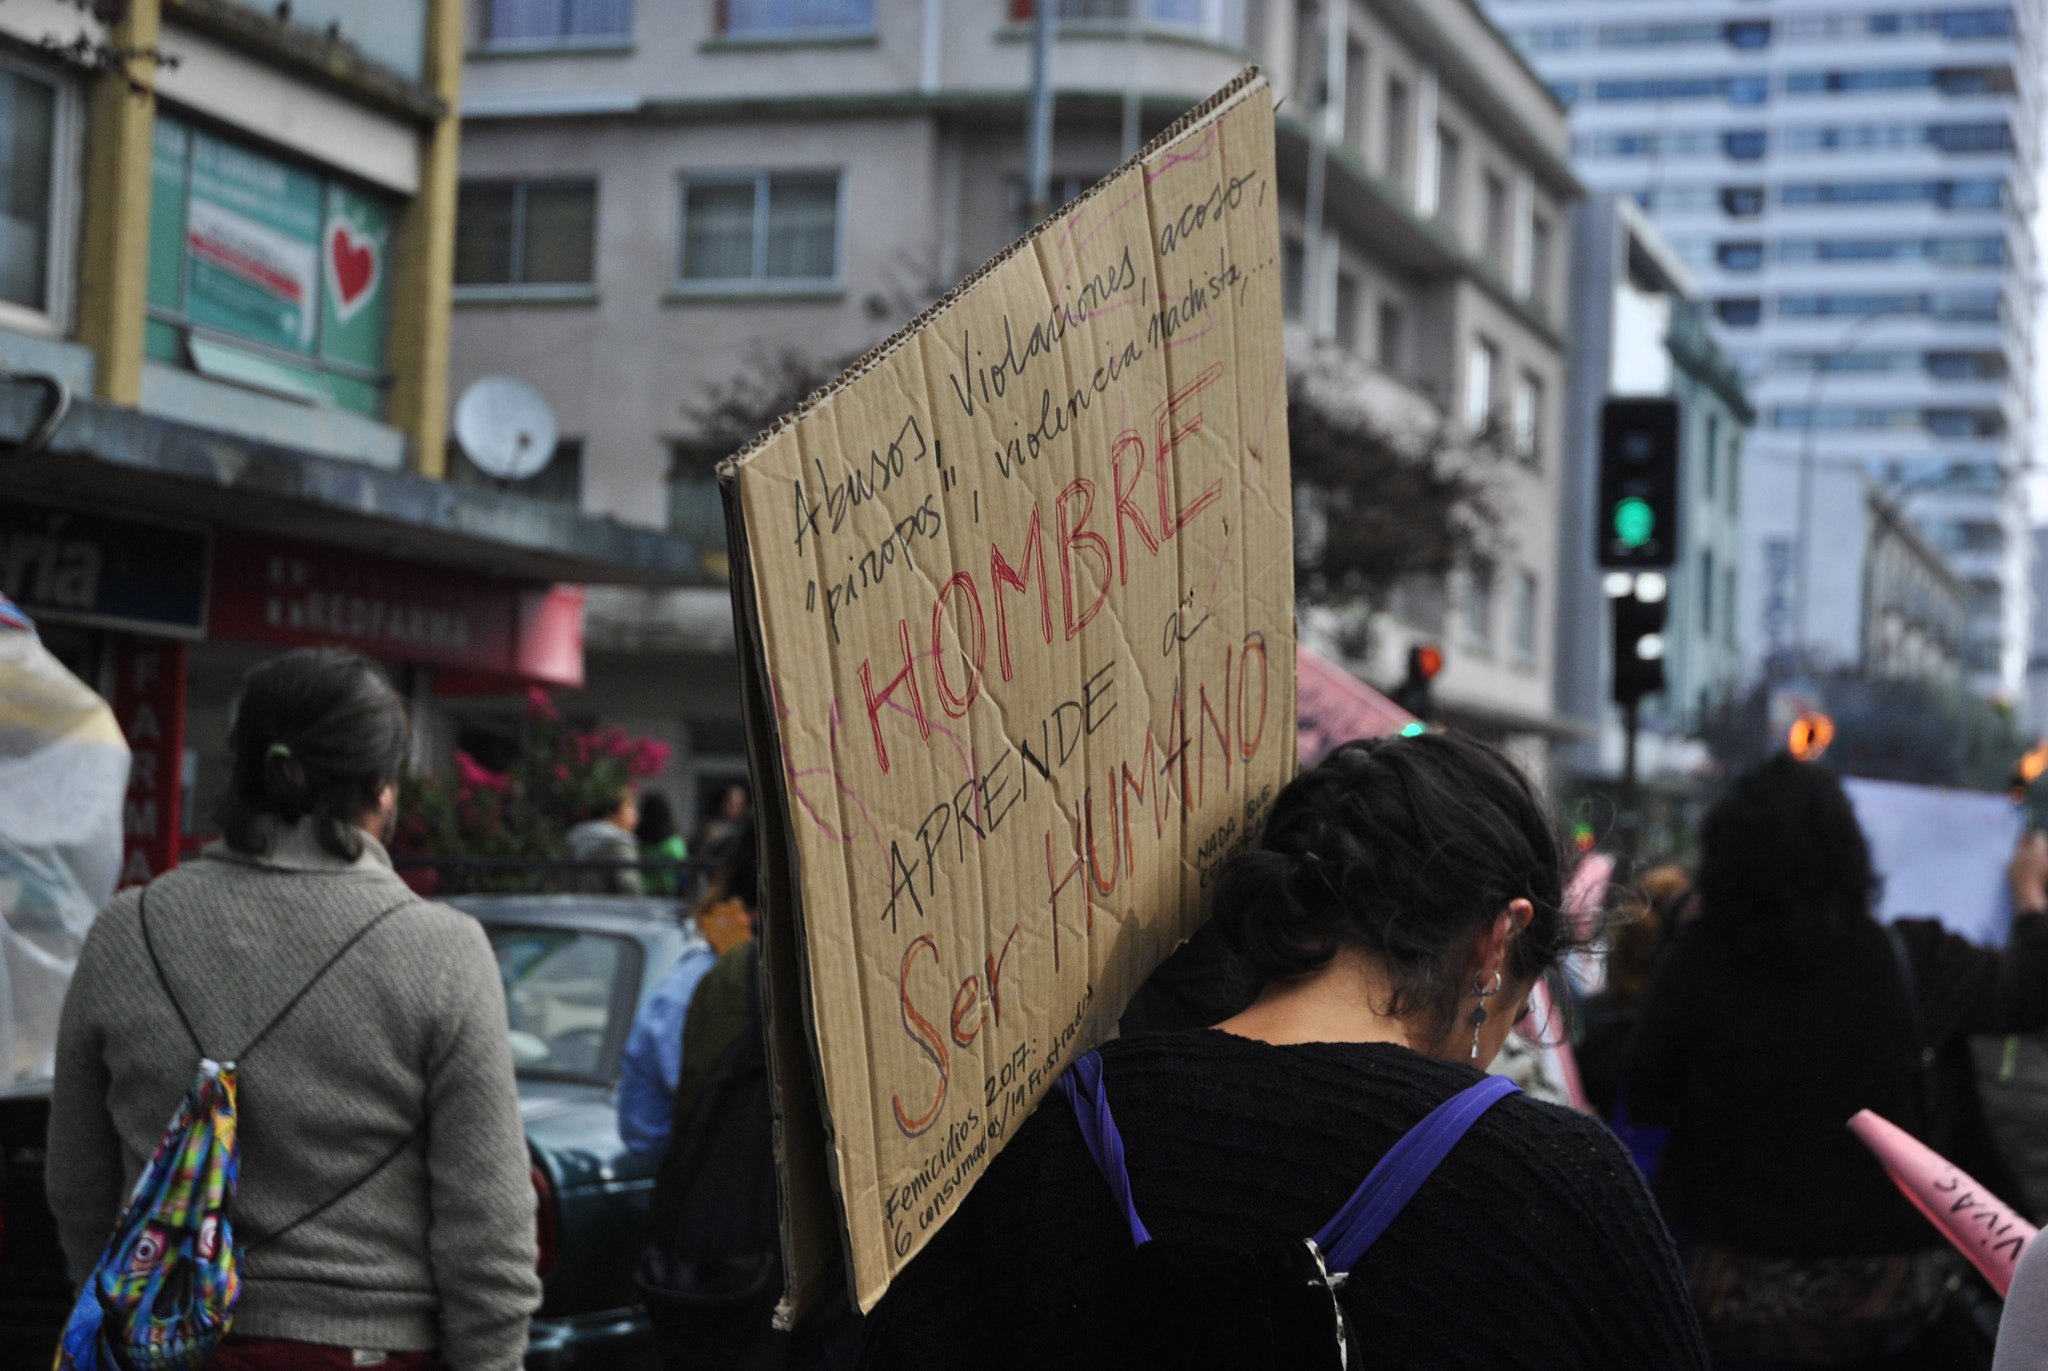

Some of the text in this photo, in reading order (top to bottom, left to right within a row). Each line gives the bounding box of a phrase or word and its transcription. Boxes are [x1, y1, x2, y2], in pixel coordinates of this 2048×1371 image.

[1160, 170, 1266, 257] acoso,
[994, 339, 1143, 479] violencia
[0, 512, 102, 609] ría
[857, 360, 1225, 777] HOMBRE
[880, 660, 1118, 935] APRENDE
[1162, 610, 1209, 658] a
[891, 630, 1268, 1139] Ser HUMANO
[1196, 815, 1236, 869] NADA
[884, 1107, 979, 1229] Femicidios
[894, 1220, 912, 1258] 6
